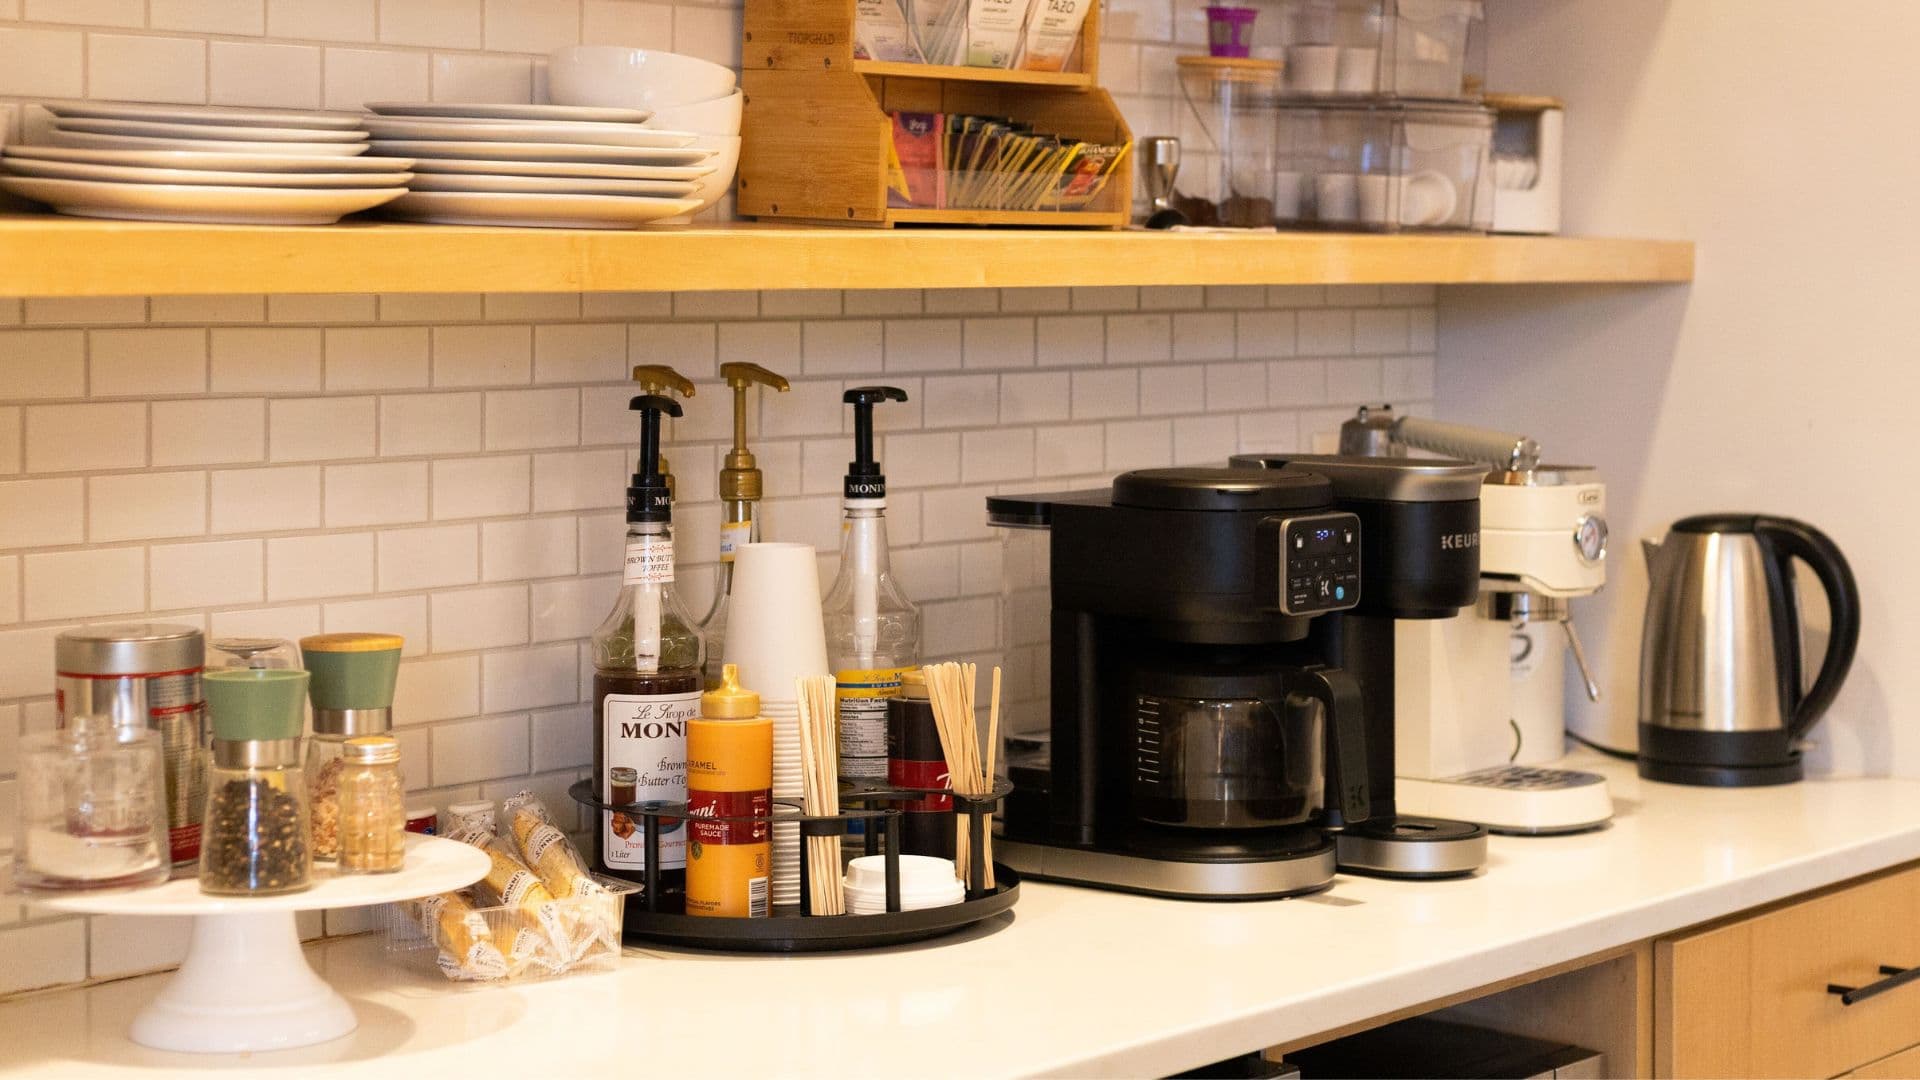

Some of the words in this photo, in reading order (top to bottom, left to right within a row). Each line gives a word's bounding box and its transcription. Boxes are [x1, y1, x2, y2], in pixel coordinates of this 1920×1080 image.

[631, 704, 653, 719] Le
[654, 703, 685, 722] Sirop
[686, 707, 696, 717] de
[657, 756, 688, 772] Brown
[639, 771, 671, 787] Butter
[671, 774, 687, 789] To
[694, 822, 730, 831] PUREMADE
[700, 830, 722, 838] SAUCE
[615, 850, 631, 859] Liter
